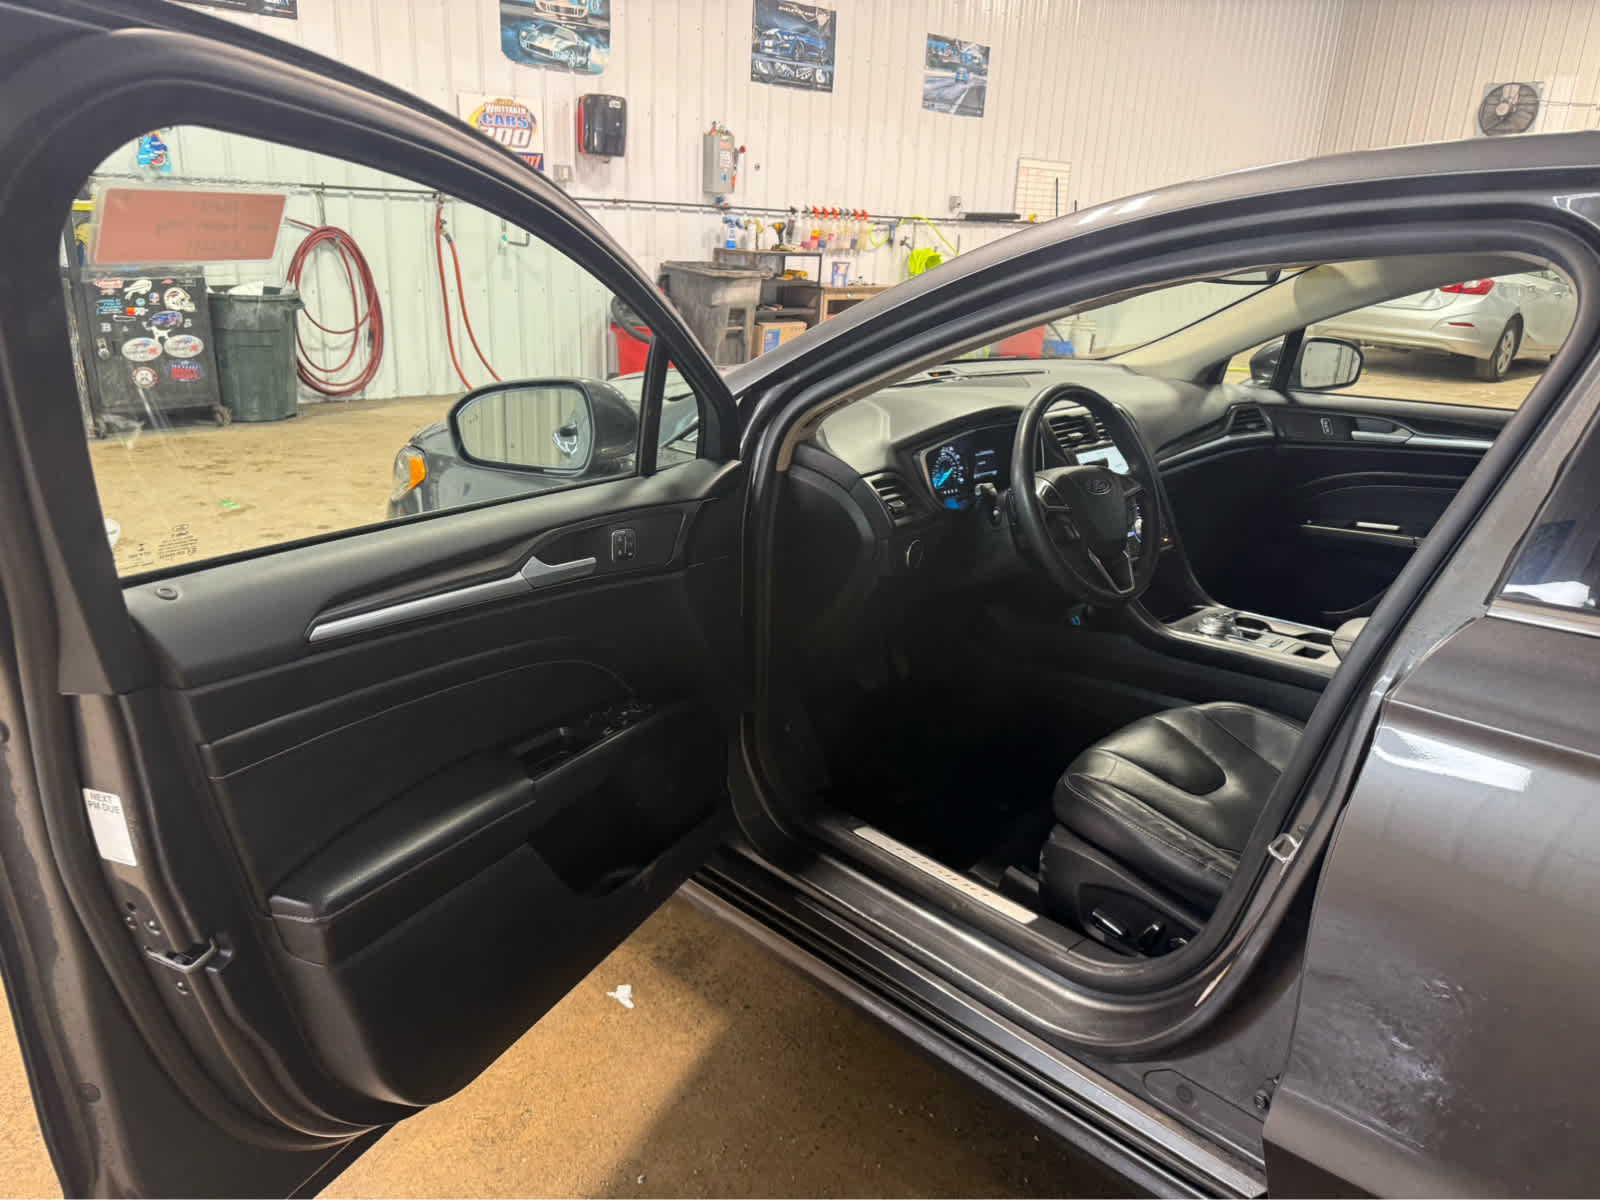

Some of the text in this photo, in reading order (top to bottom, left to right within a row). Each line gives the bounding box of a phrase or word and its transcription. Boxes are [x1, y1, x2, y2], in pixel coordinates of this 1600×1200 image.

[482, 113, 529, 128] CARS
[90, 792, 113, 802] NEXT
[101, 802, 121, 815] DUE
